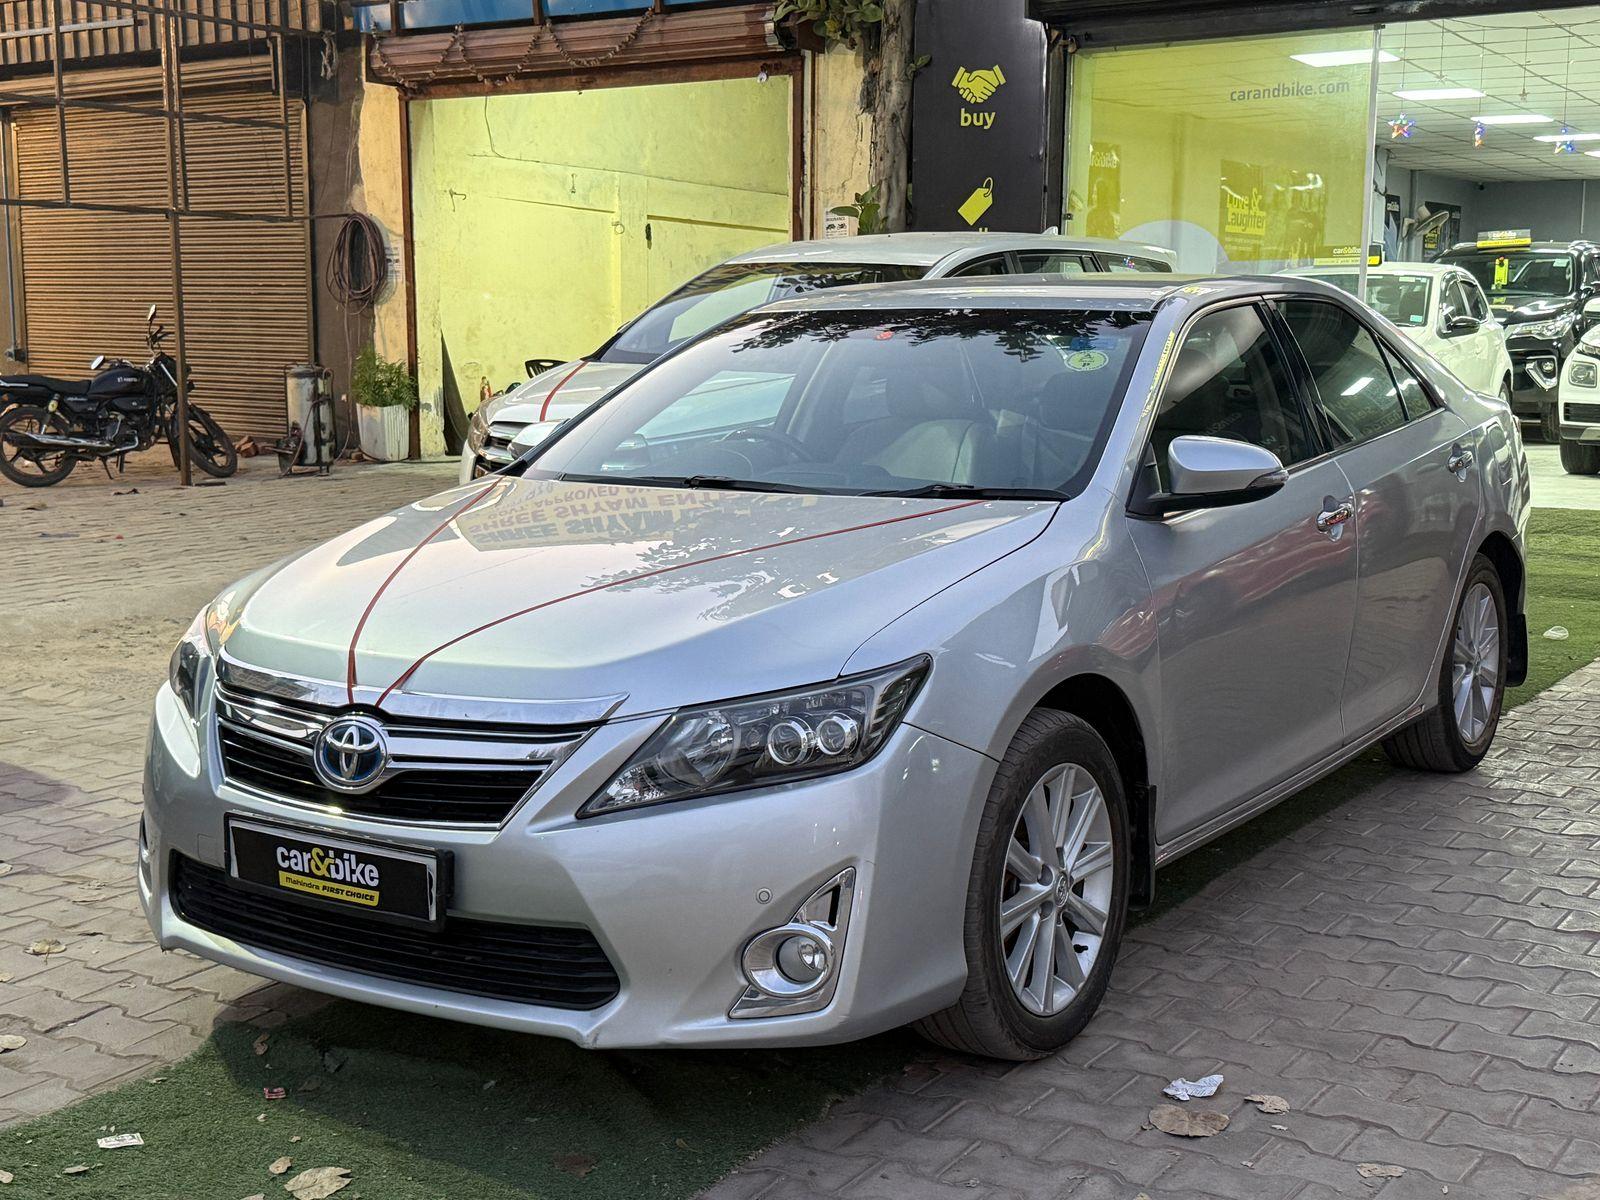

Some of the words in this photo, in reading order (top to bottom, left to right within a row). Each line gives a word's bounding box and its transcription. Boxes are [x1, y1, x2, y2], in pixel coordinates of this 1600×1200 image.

[1230, 81, 1350, 102] carandbike.com
[960, 107, 996, 130] buy
[276, 846, 380, 887] car&bike
[285, 876, 321, 891] Mahindra
[322, 884, 345, 896] FIRST
[345, 890, 375, 902] CHOICE
